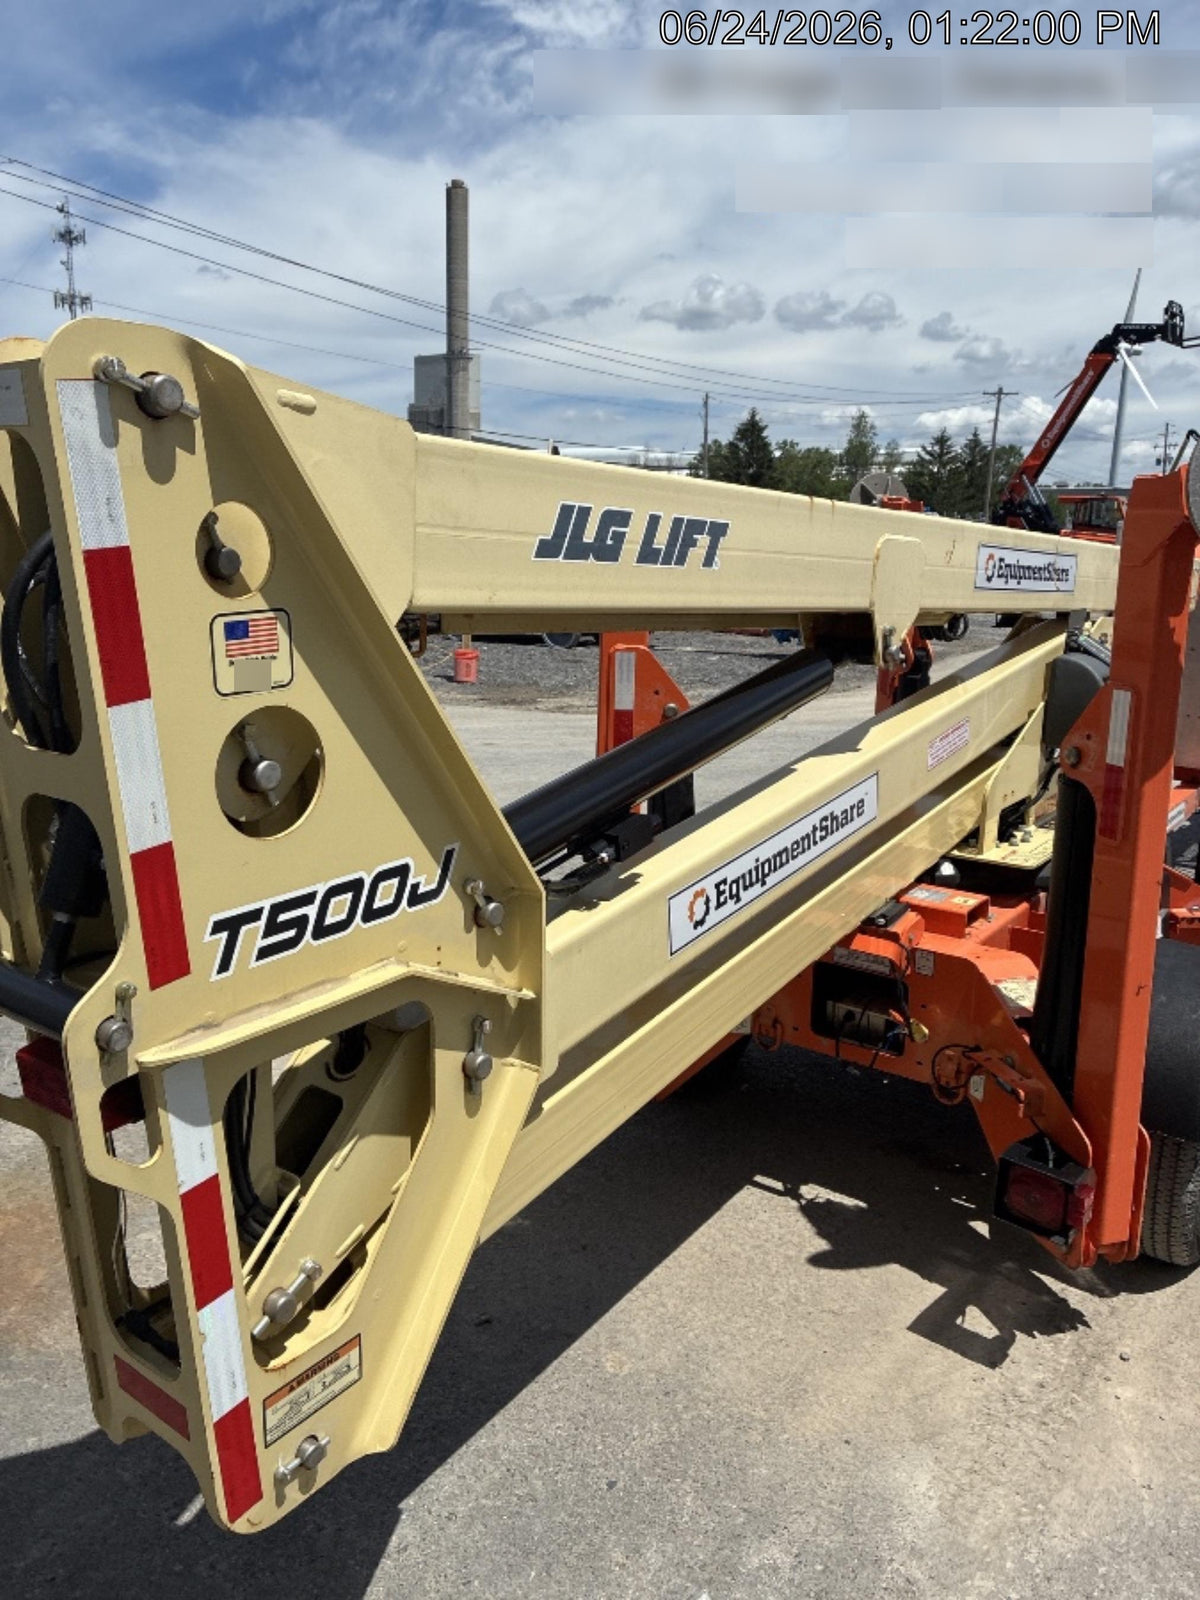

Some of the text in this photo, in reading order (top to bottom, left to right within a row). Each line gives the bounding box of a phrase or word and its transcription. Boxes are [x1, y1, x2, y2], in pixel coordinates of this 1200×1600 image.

[533, 501, 731, 569] JLG LIFT
[714, 796, 867, 911] EquipmentShare
[206, 845, 458, 978] T500J
